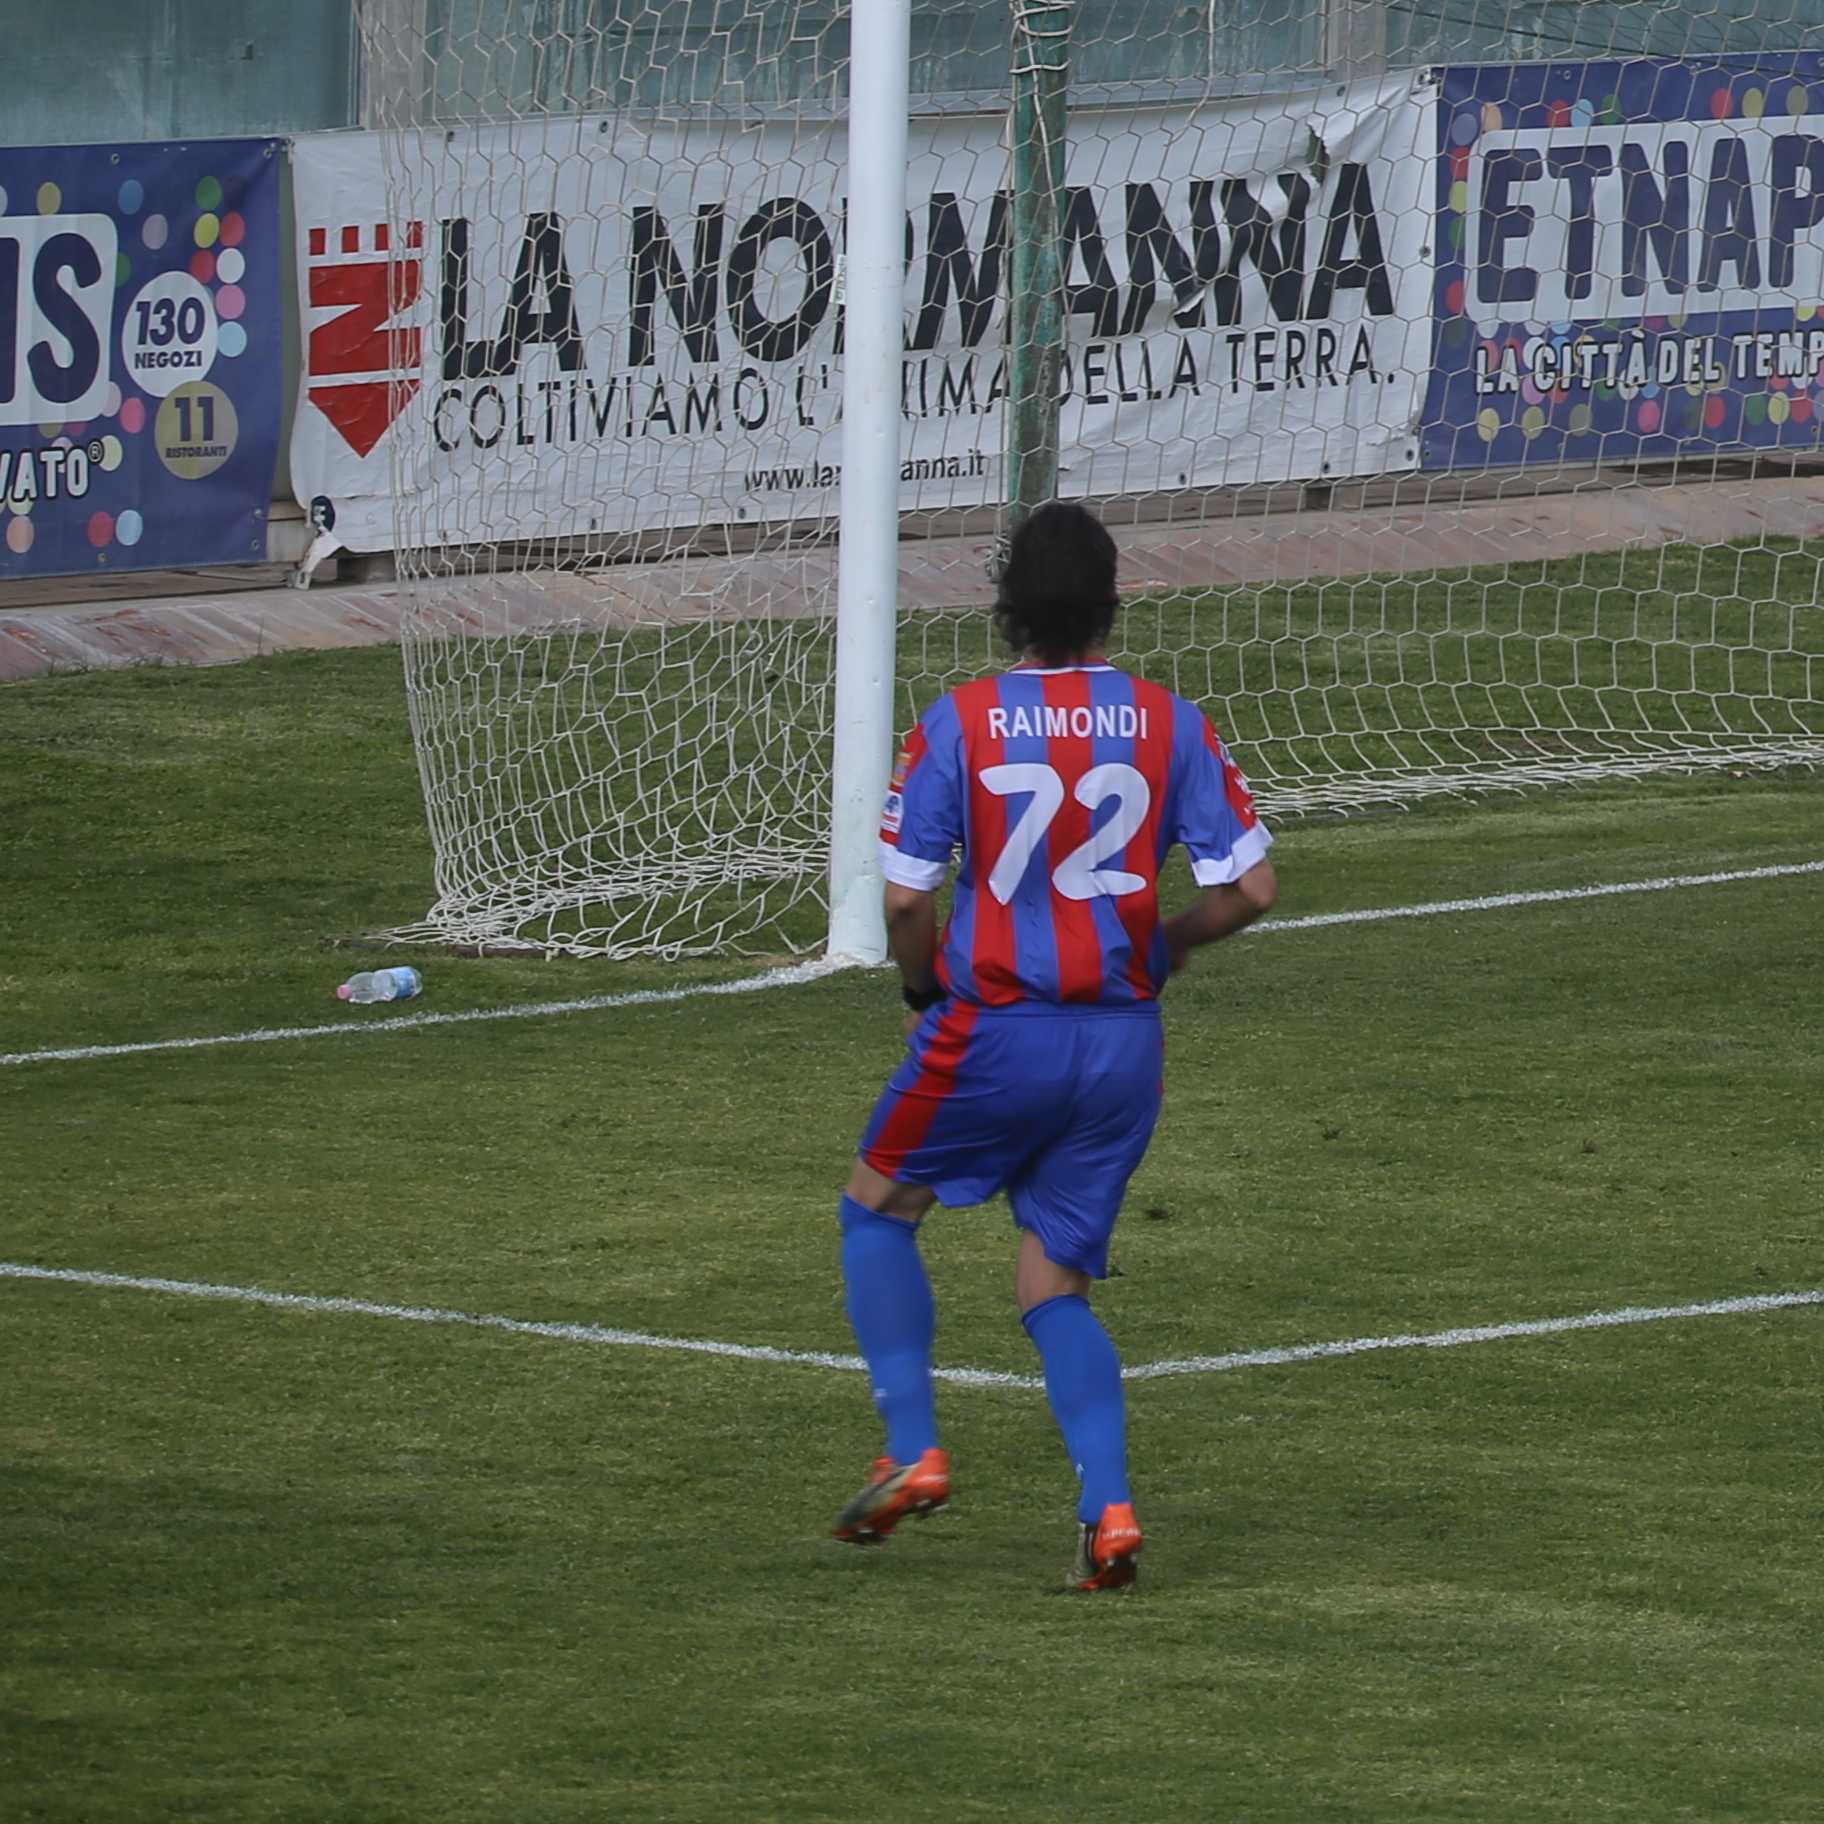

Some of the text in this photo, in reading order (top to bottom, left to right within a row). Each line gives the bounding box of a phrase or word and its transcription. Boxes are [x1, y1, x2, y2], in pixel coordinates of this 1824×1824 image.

[441, 162, 1394, 381] LA NOMANNA
[135, 297, 206, 346] 130
[133, 350, 203, 370] NEGOZI
[1476, 344, 1520, 394] LA
[1530, 329, 1650, 391] CITTÀ
[1656, 336, 1722, 385] DEL
[432, 367, 770, 452] COLTIVIAMO
[1224, 323, 1396, 392] TERRA.
[173, 397, 216, 442] 11
[164, 444, 228, 460] RISTORANTI
[987, 706, 1148, 740] RAIMONDI
[978, 762, 1151, 906] 72
